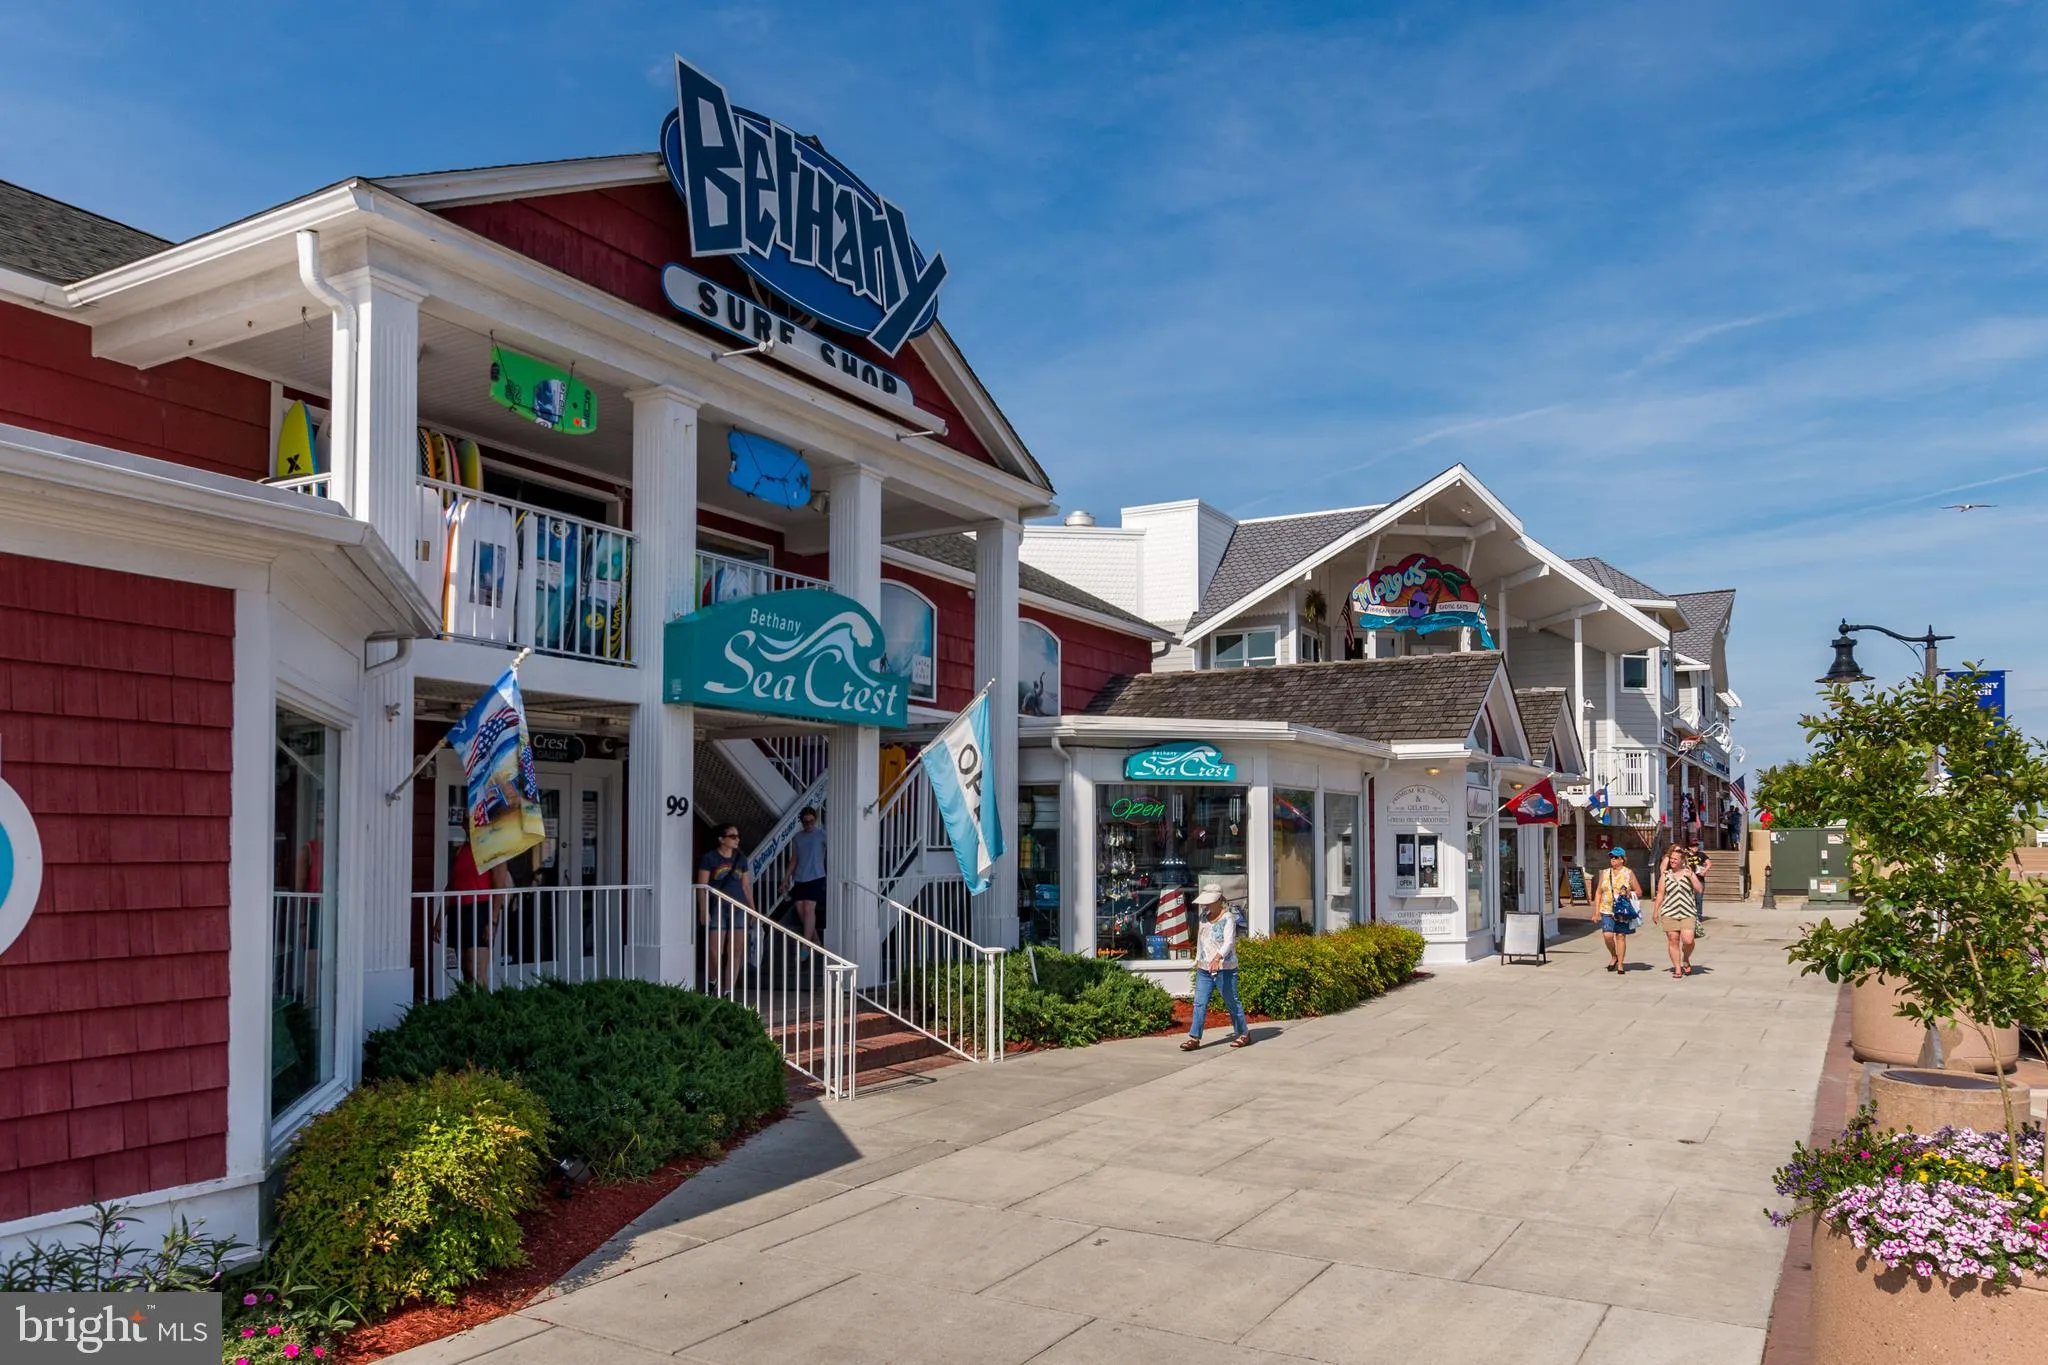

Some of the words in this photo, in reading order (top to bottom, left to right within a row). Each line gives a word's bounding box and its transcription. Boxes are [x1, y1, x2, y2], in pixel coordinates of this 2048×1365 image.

[697, 281, 796, 345] SURF
[820, 342, 898, 395] SHOP
[749, 608, 802, 636] Bethany
[703, 630, 796, 701] Sea
[804, 649, 898, 717] Crest
[533, 734, 569, 750] Crest
[1134, 756, 1176, 776] Sea
[1180, 758, 1231, 777] Crest
[666, 795, 689, 817] 99
[1111, 798, 1166, 821] Open
[1400, 879, 1413, 887] OPEN
